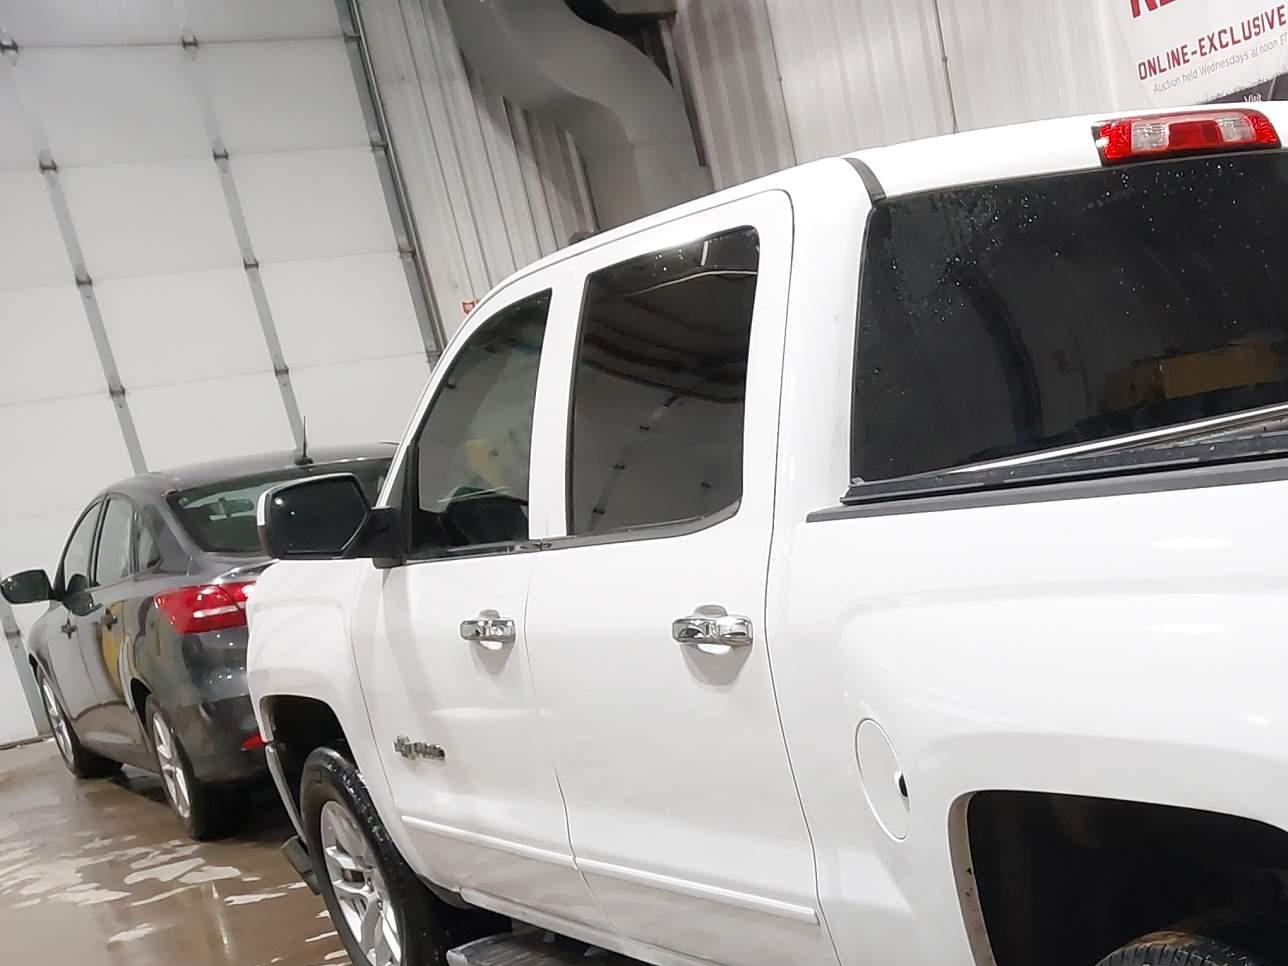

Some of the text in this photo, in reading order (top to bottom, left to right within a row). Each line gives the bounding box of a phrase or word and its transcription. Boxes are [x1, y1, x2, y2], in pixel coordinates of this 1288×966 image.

[1138, 5, 1287, 80] ONLINE-EXCLUSIVE
[1153, 76, 1181, 95] Auction
[1182, 70, 1198, 84] held
[1199, 50, 1249, 76] Wednesdays
[1260, 39, 1278, 54] noon
